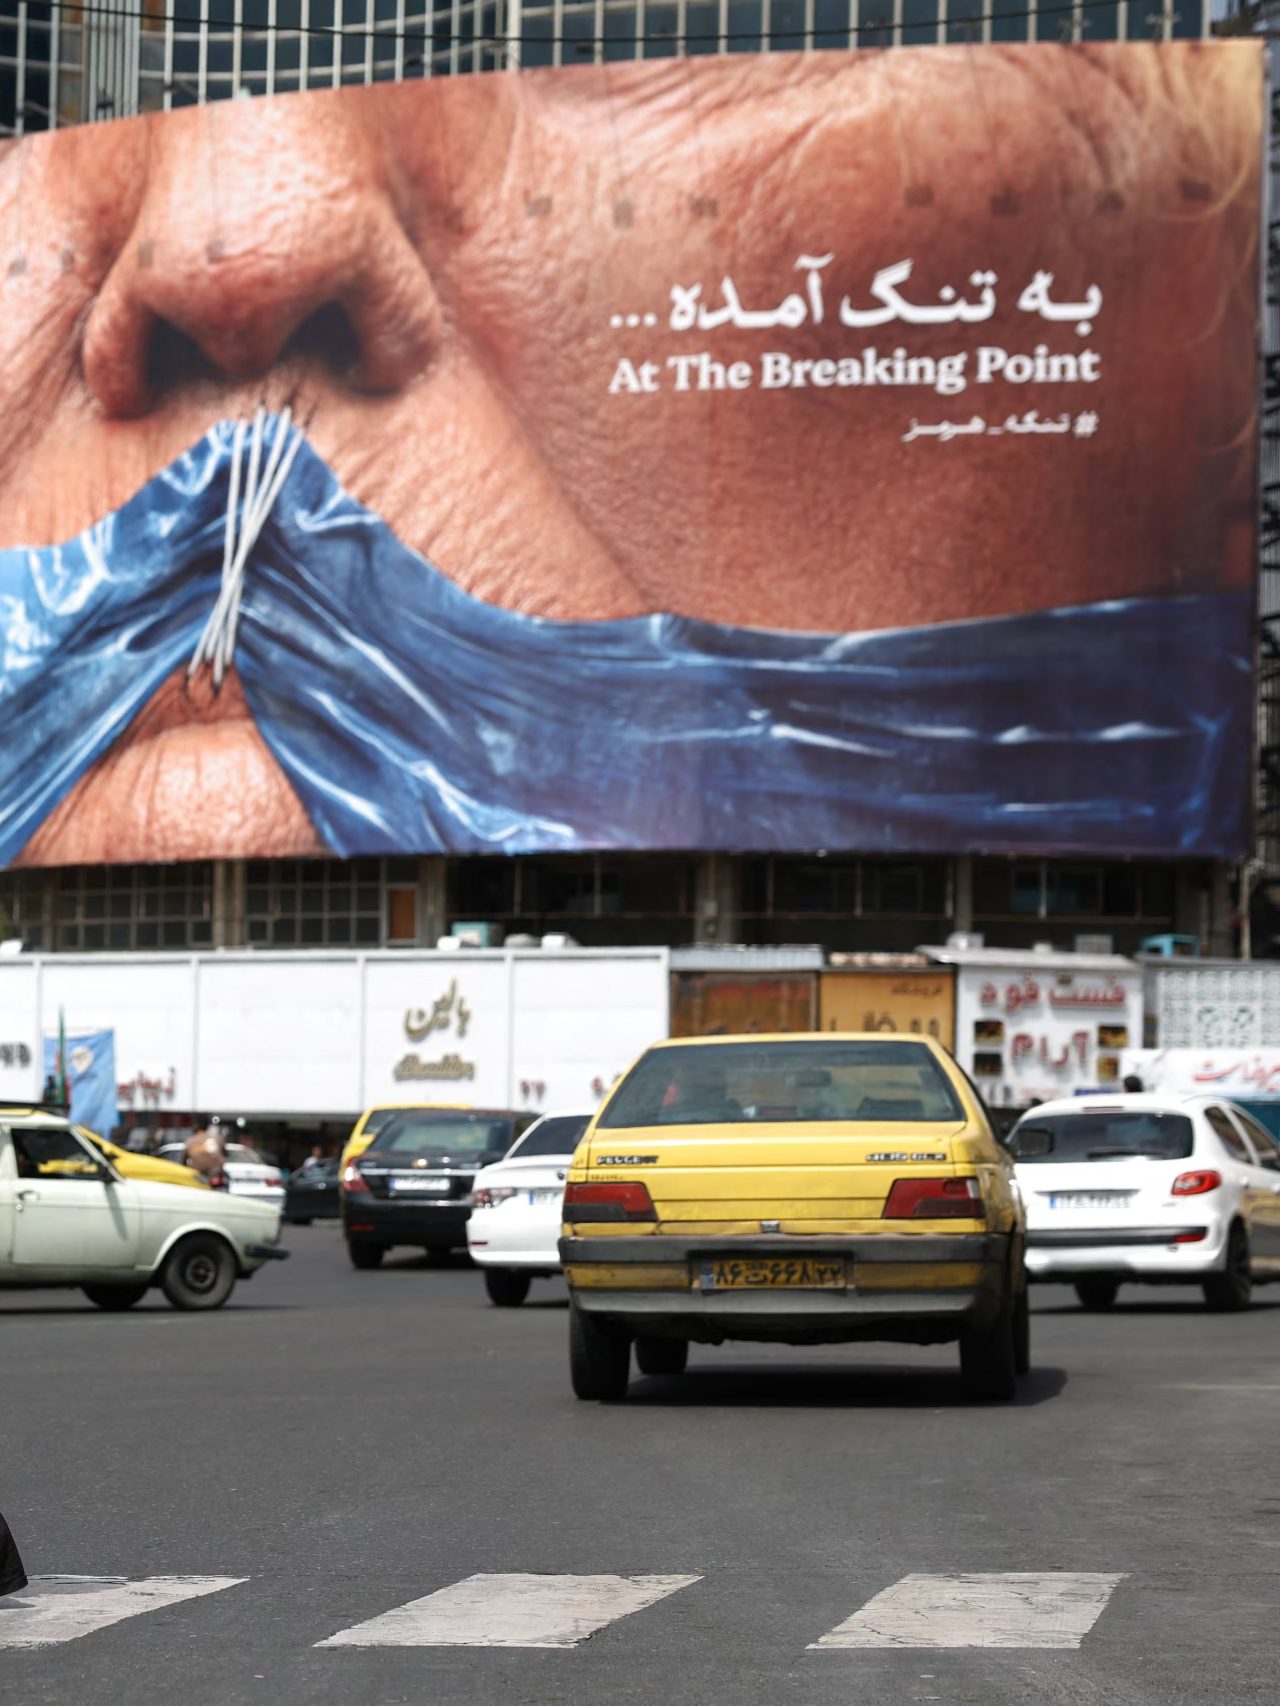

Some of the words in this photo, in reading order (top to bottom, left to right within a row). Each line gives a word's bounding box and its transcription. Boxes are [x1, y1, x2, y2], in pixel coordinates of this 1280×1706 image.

[668, 251, 835, 332] آمده
[839, 258, 999, 328] تنگ
[1017, 269, 1103, 337] به
[608, 357, 660, 395] At
[666, 352, 754, 392] The
[760, 346, 969, 396] Breaking
[975, 343, 1101, 385] Point
[596, 1155, 658, 1165] PEUGE
